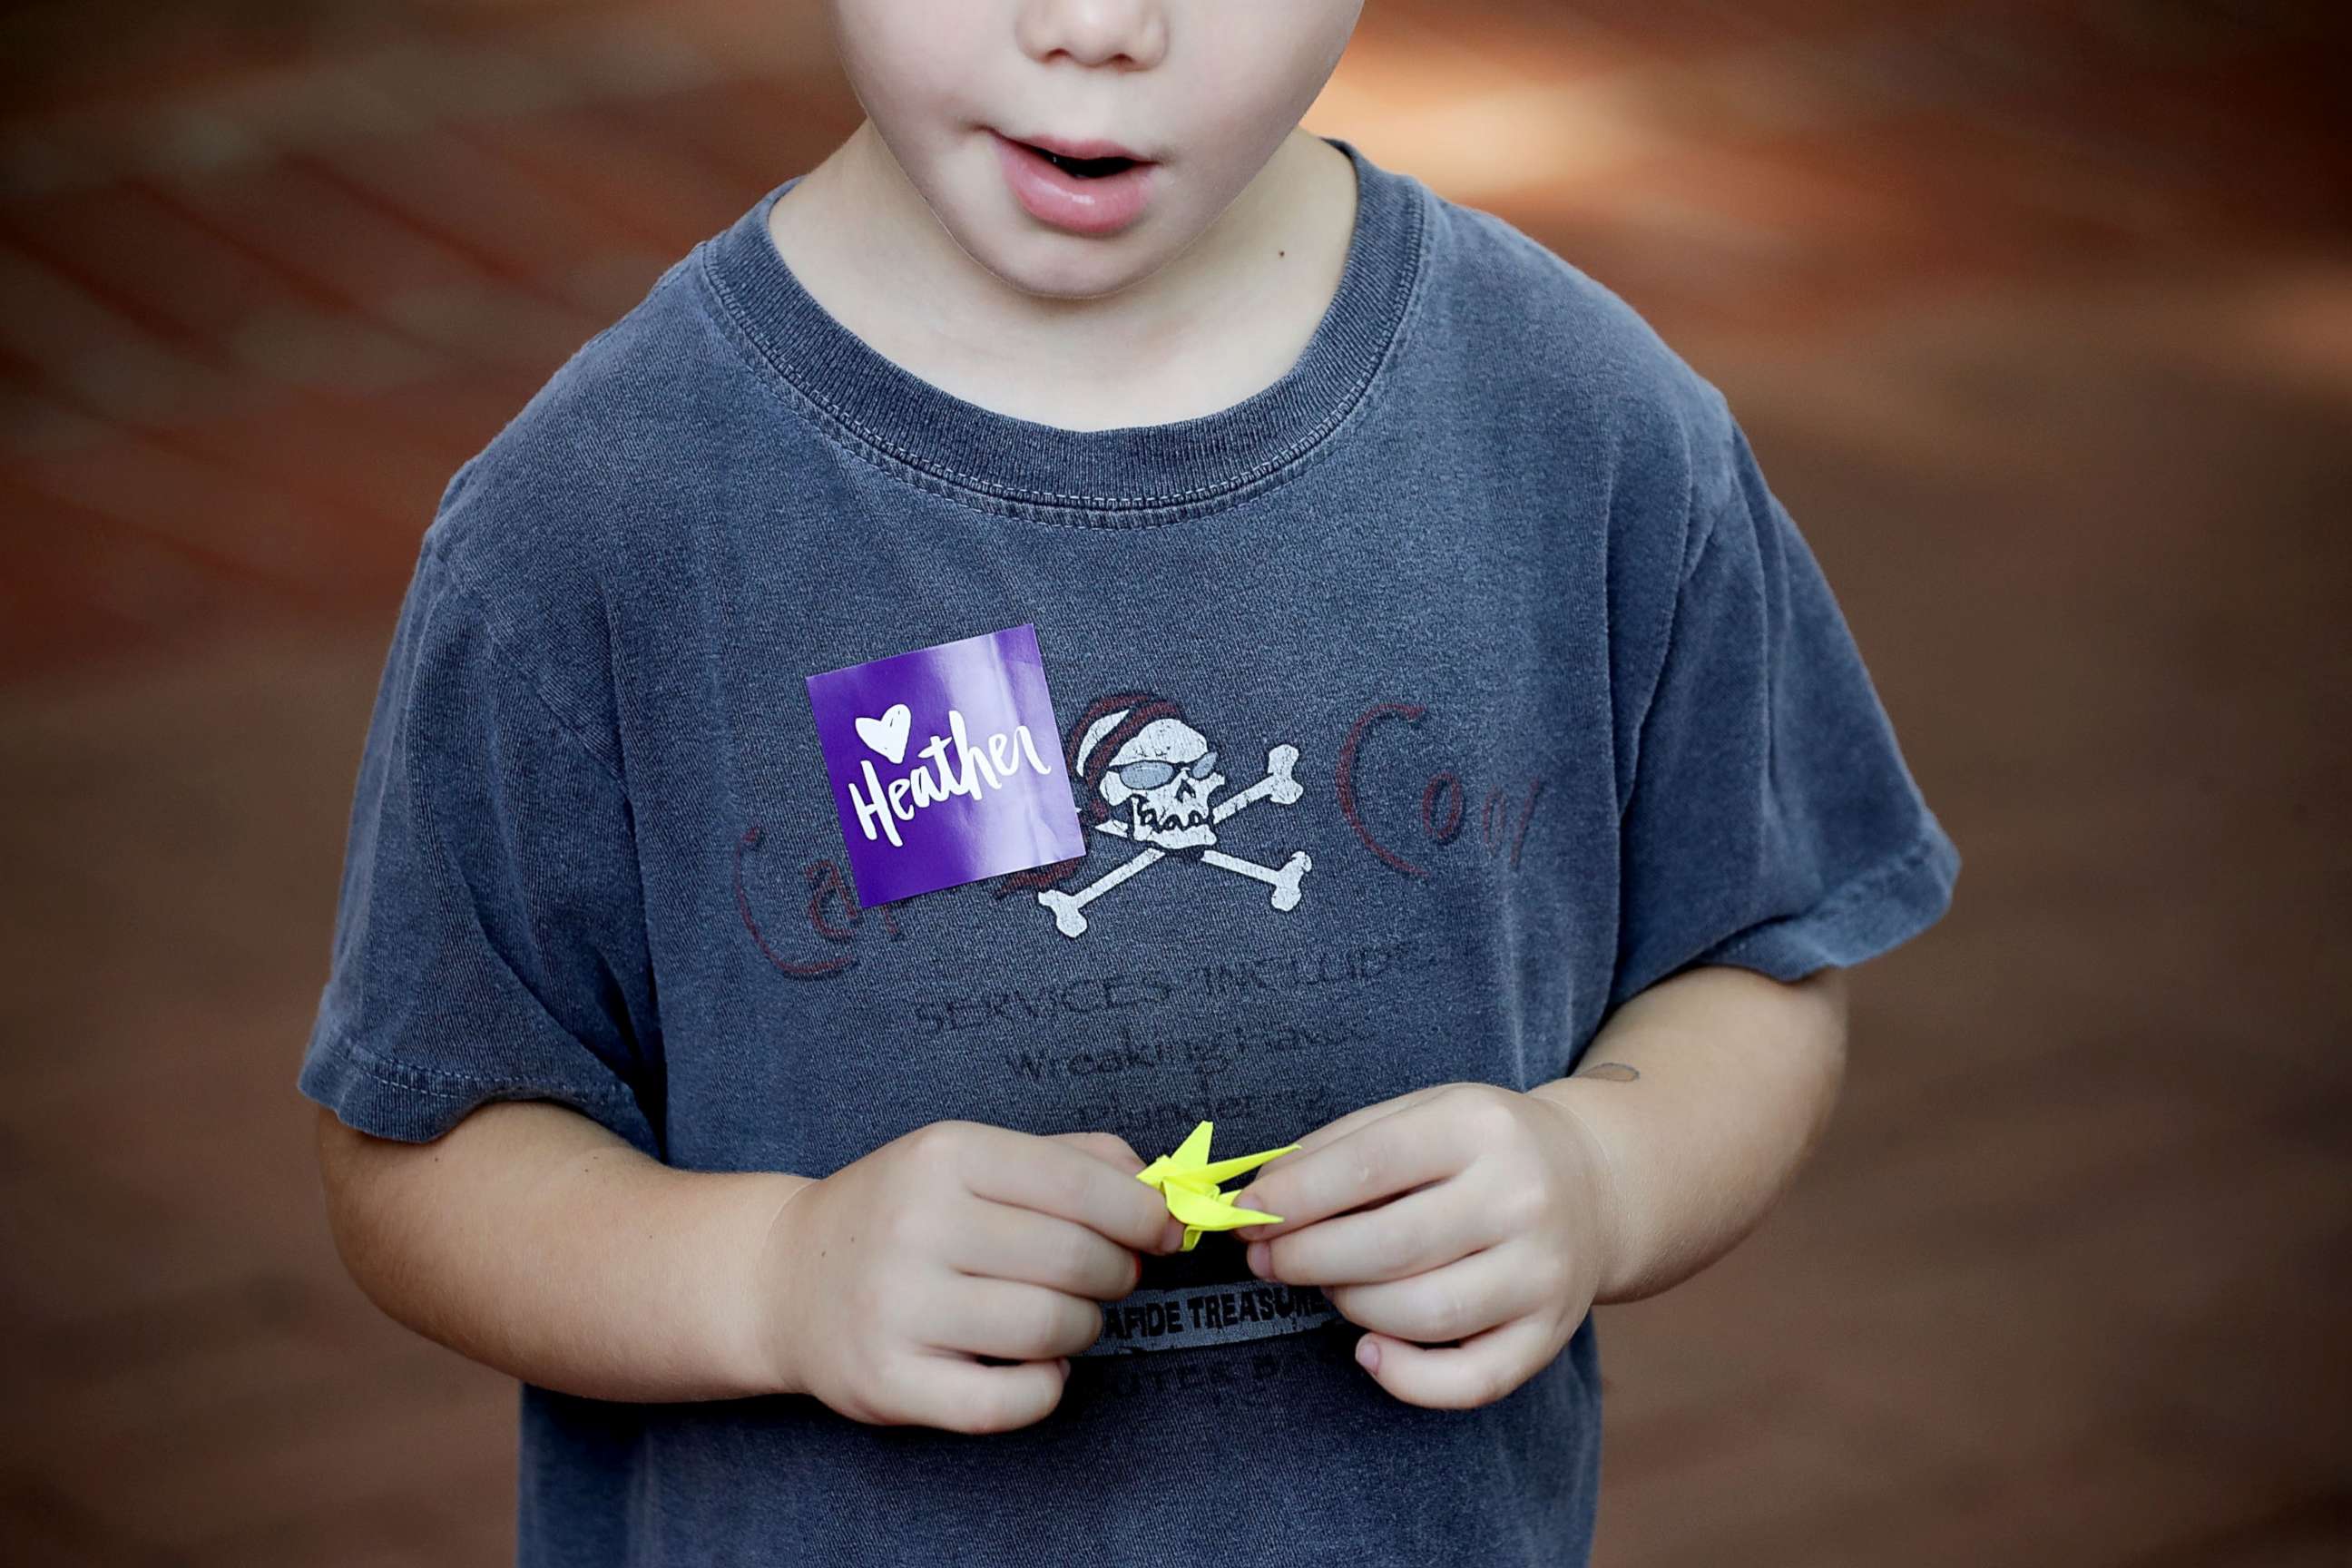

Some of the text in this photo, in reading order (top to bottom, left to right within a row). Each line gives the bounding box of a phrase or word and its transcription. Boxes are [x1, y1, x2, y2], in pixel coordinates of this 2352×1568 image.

[847, 710, 1052, 848] Heather
[916, 970, 1173, 1034] SERVICES
[1004, 1025, 1231, 1081] Wreaking
[1102, 1300, 1183, 1339] AFIDE
